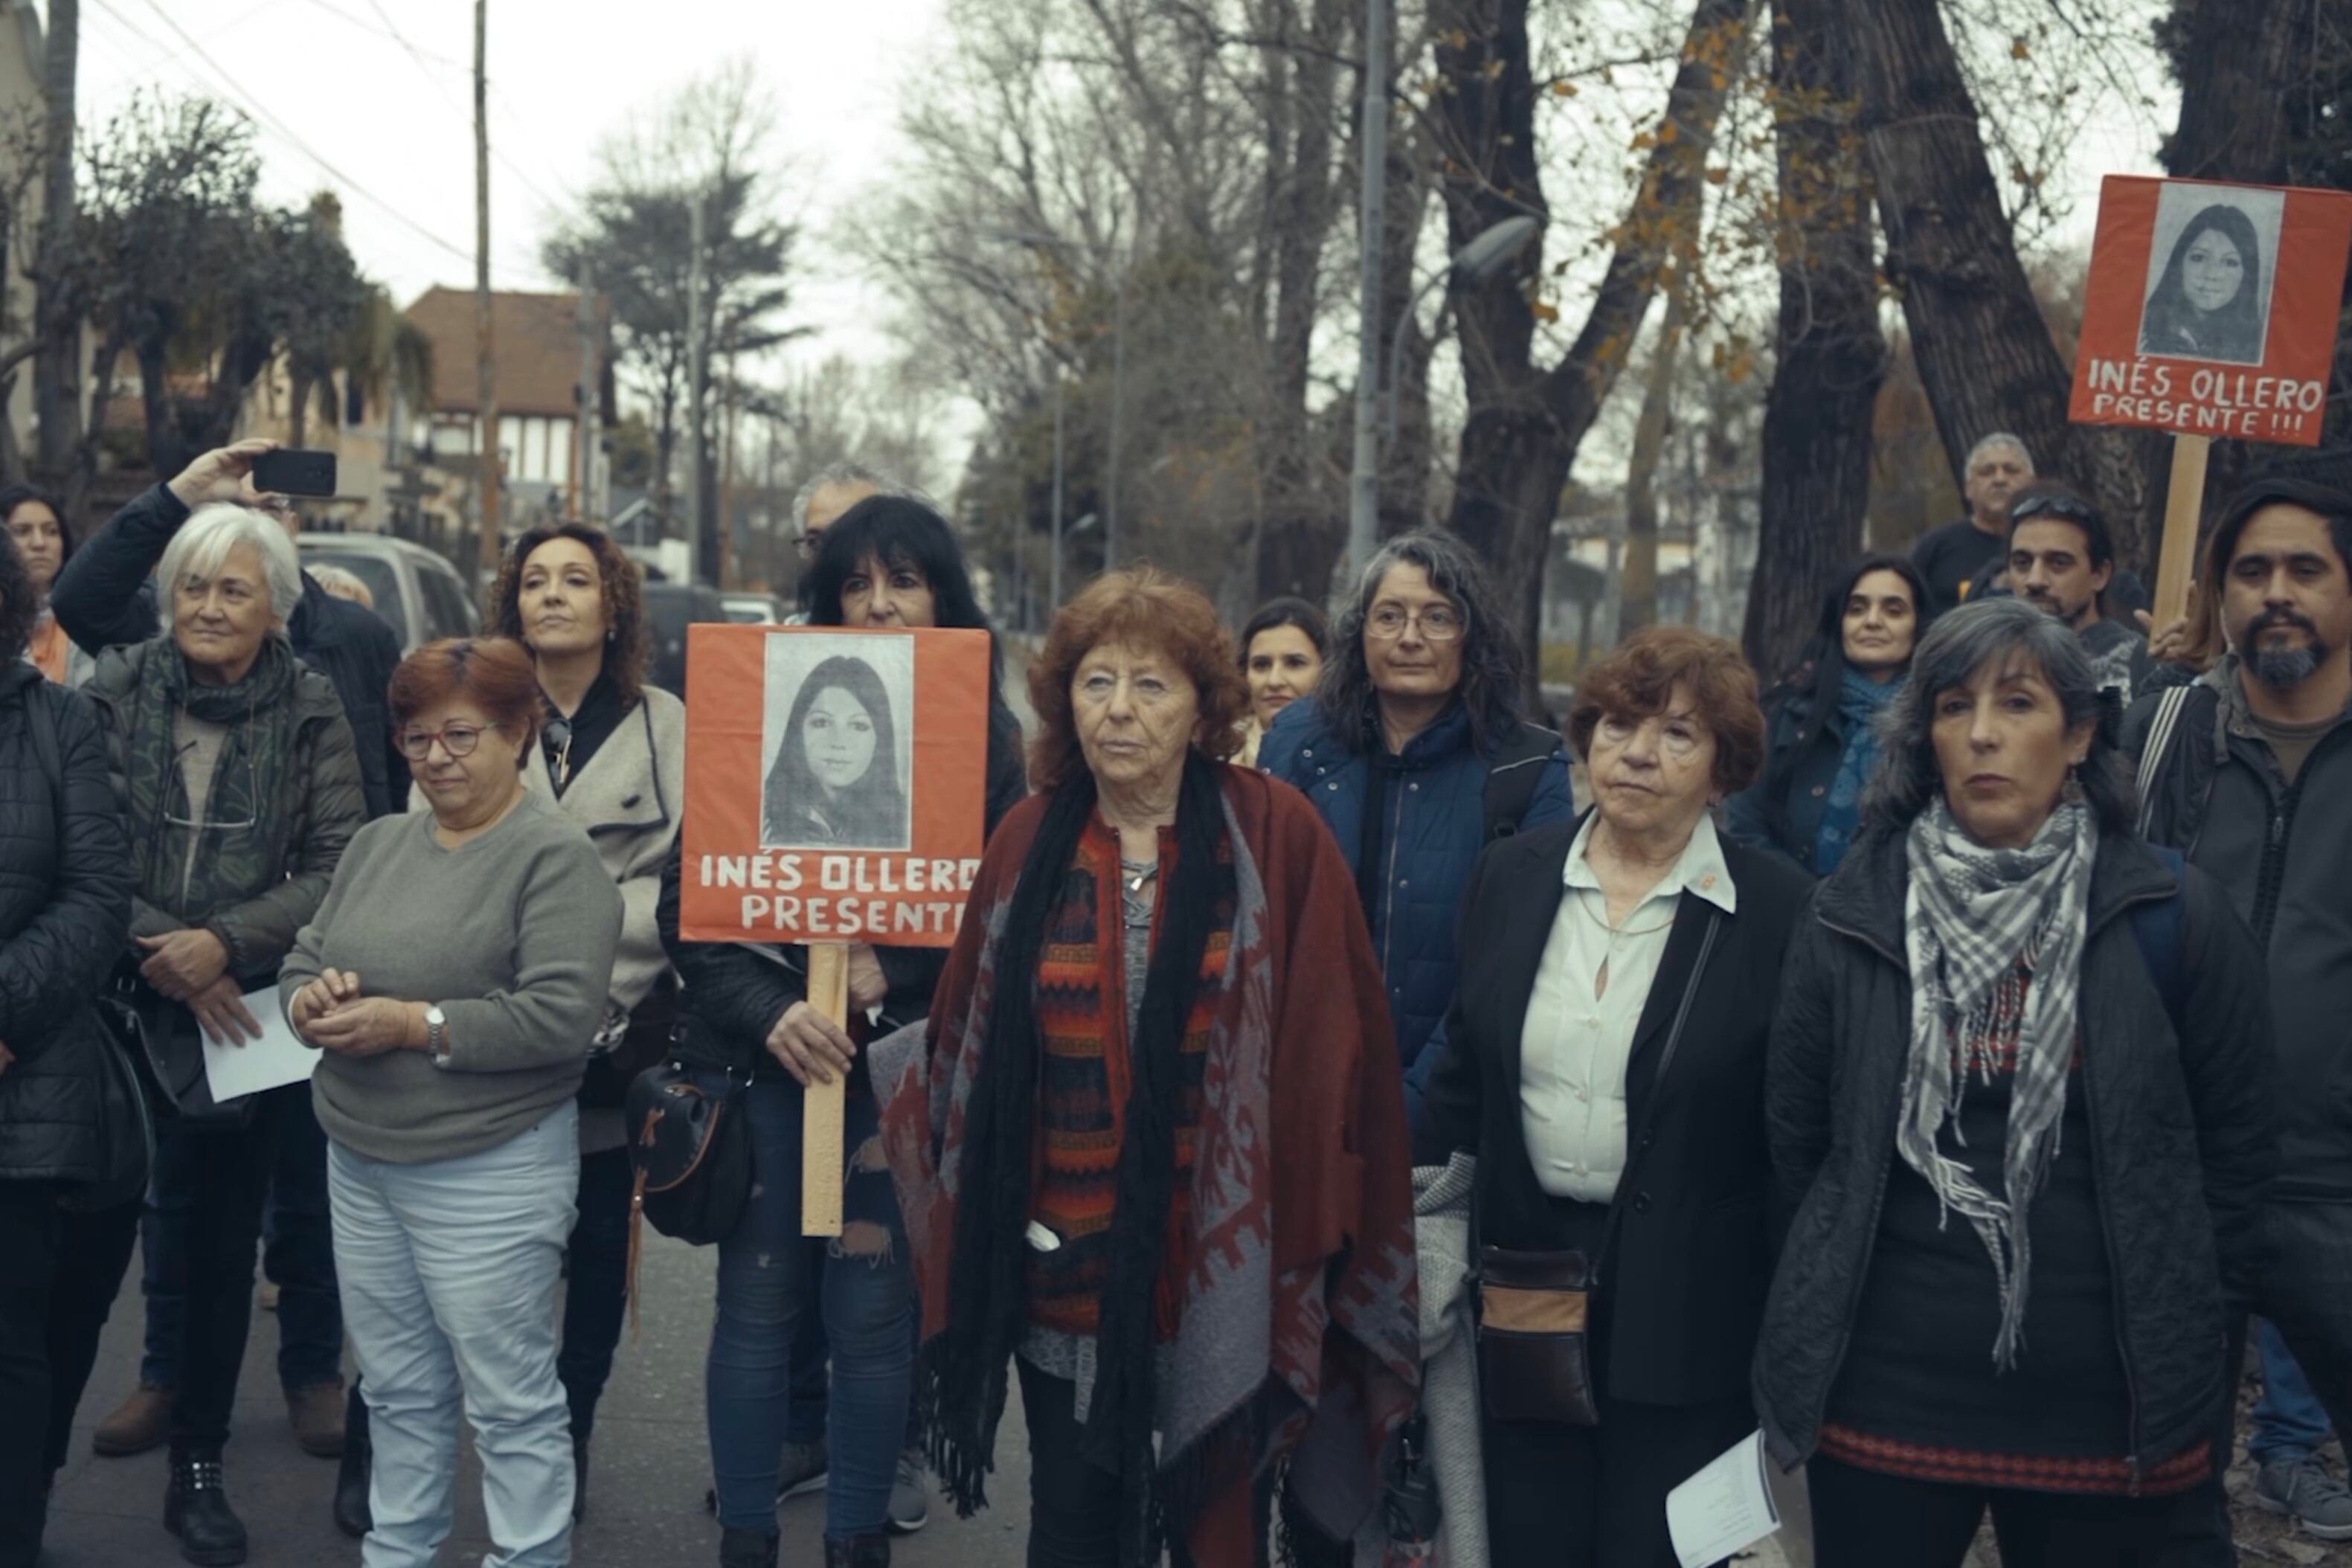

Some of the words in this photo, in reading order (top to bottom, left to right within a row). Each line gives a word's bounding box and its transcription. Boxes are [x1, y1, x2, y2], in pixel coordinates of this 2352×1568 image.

[2087, 356, 2171, 396] INÉS
[2190, 370, 2323, 412] OLLERO
[2093, 393, 2261, 435] PRESENTE
[700, 849, 803, 891] INÉS
